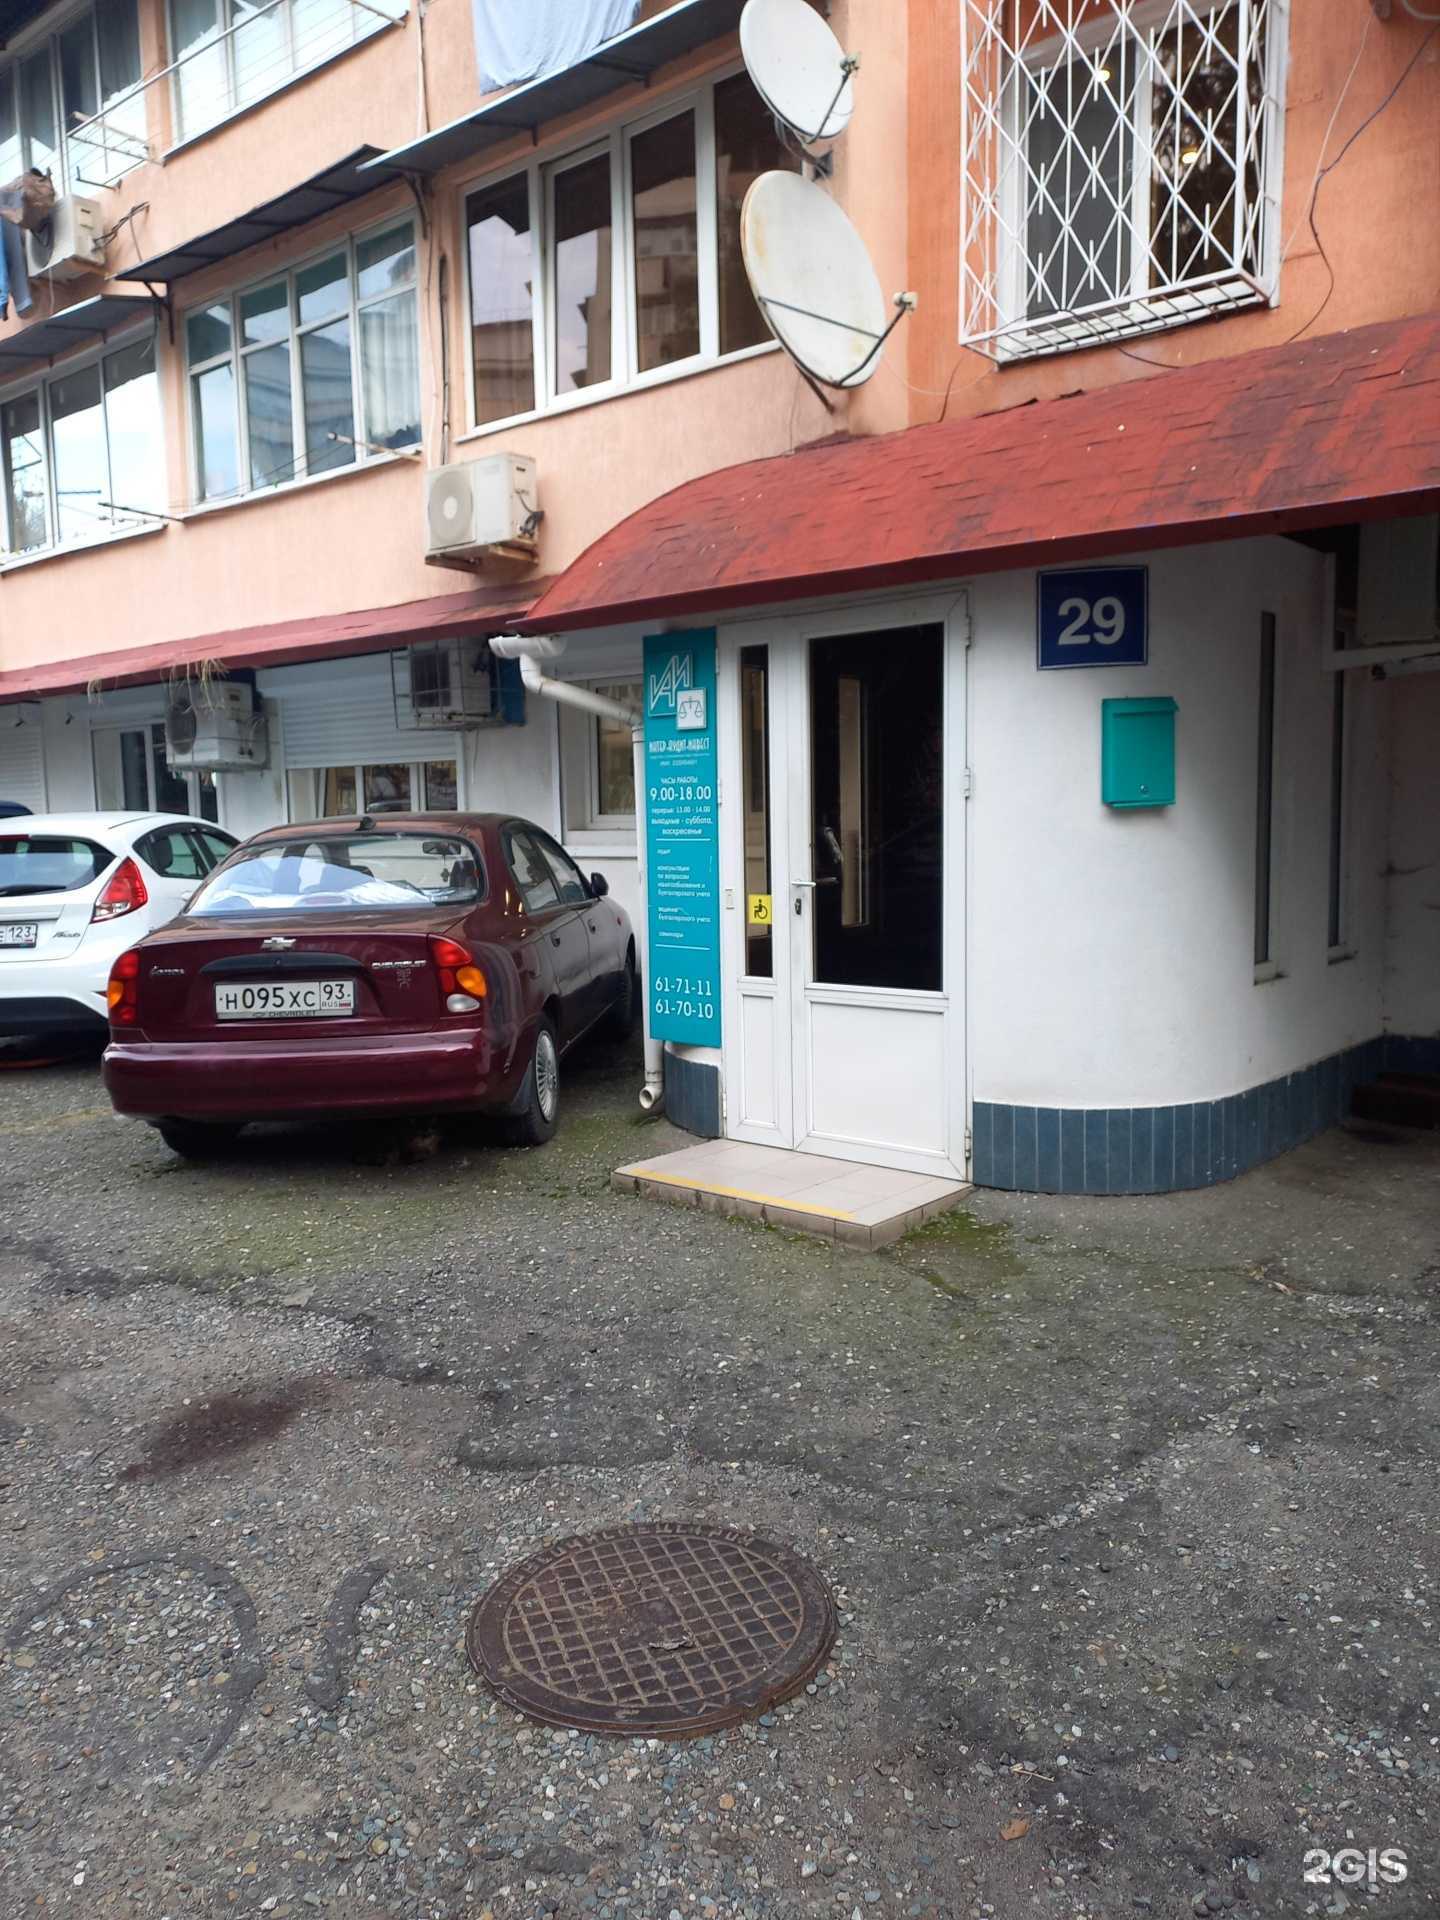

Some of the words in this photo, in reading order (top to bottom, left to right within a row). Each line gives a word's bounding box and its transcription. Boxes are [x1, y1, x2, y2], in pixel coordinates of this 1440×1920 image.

[1058, 596, 1125, 645] 29
[676, 776, 698, 784] РАБОТЫ
[650, 786, 712, 801] 9.00-18.00
[9, 926, 32, 938] 123
[323, 983, 345, 1001] 93
[655, 976, 712, 996] 61-71-11
[655, 999, 713, 1019] 61-70-10
